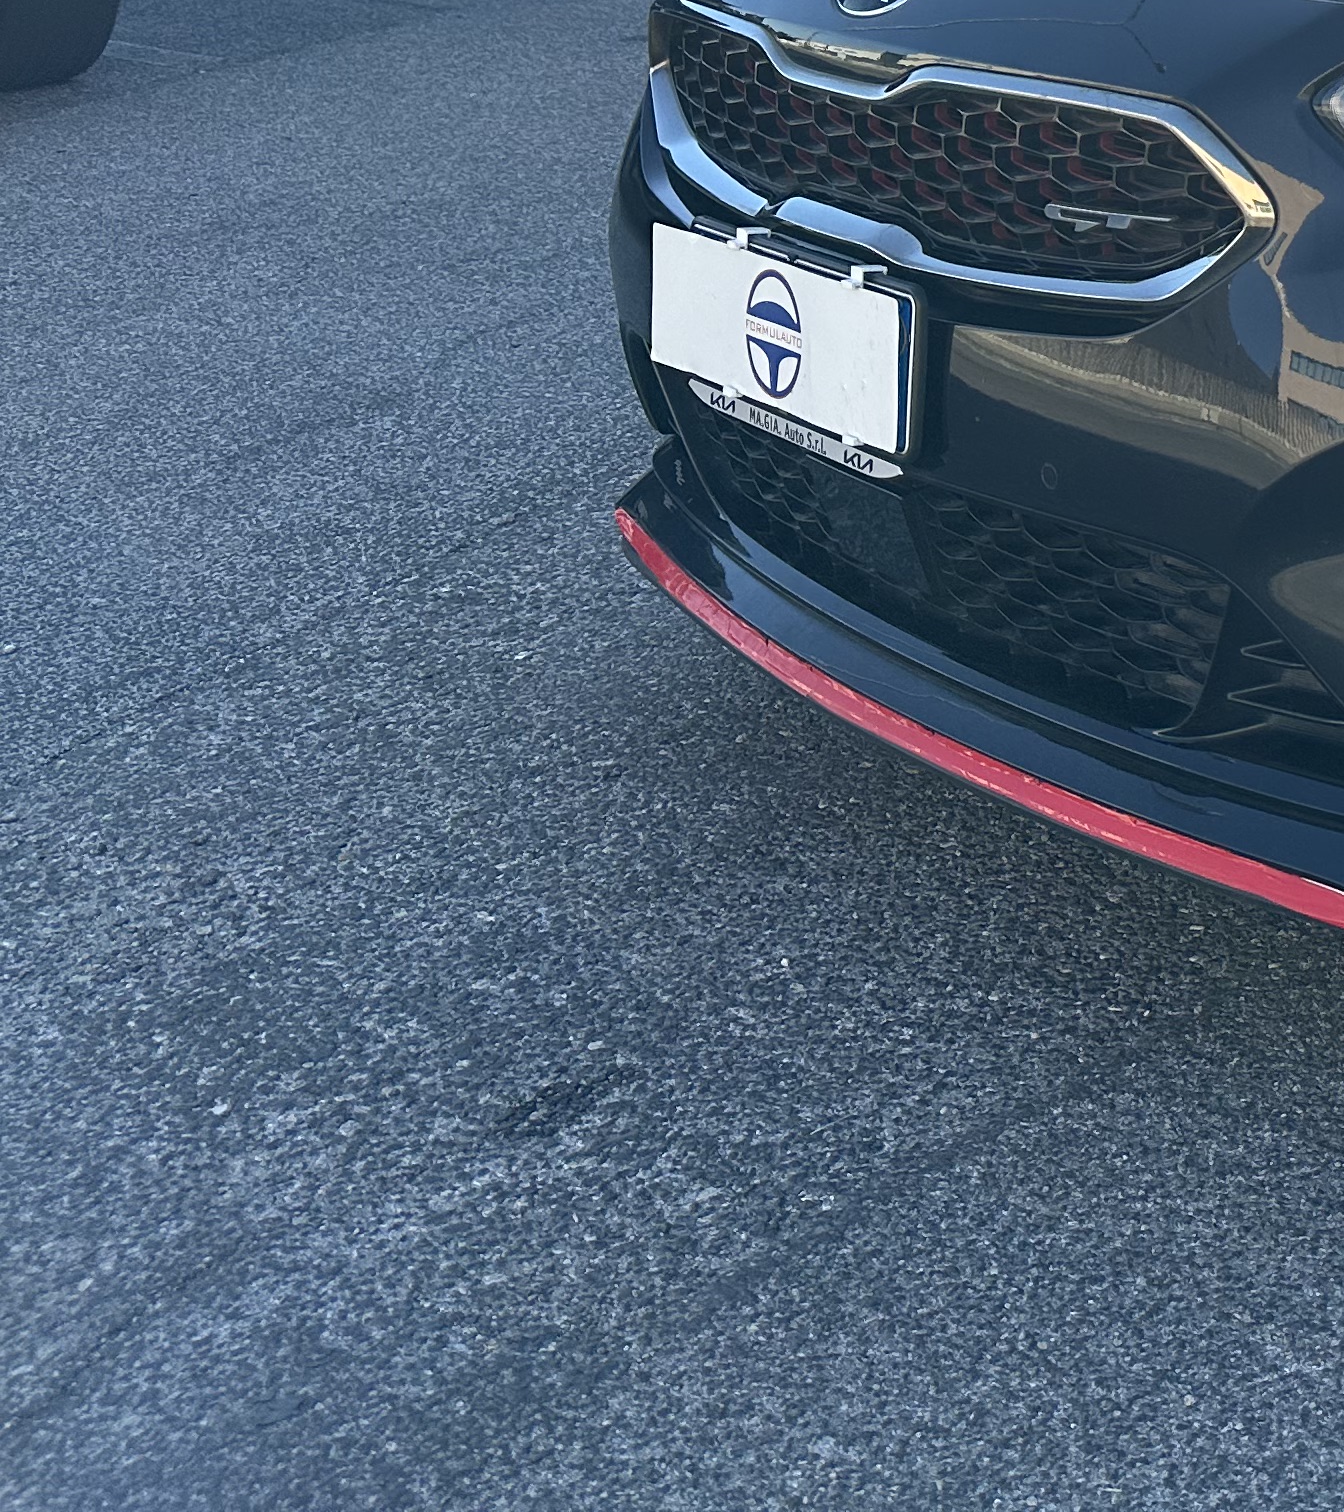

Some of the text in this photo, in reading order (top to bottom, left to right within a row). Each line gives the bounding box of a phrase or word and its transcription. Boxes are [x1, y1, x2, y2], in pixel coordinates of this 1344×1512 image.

[745, 318, 803, 349] FORMULAUTO
[749, 406, 782, 436] MA.GIA.
[784, 422, 804, 446] Auto
